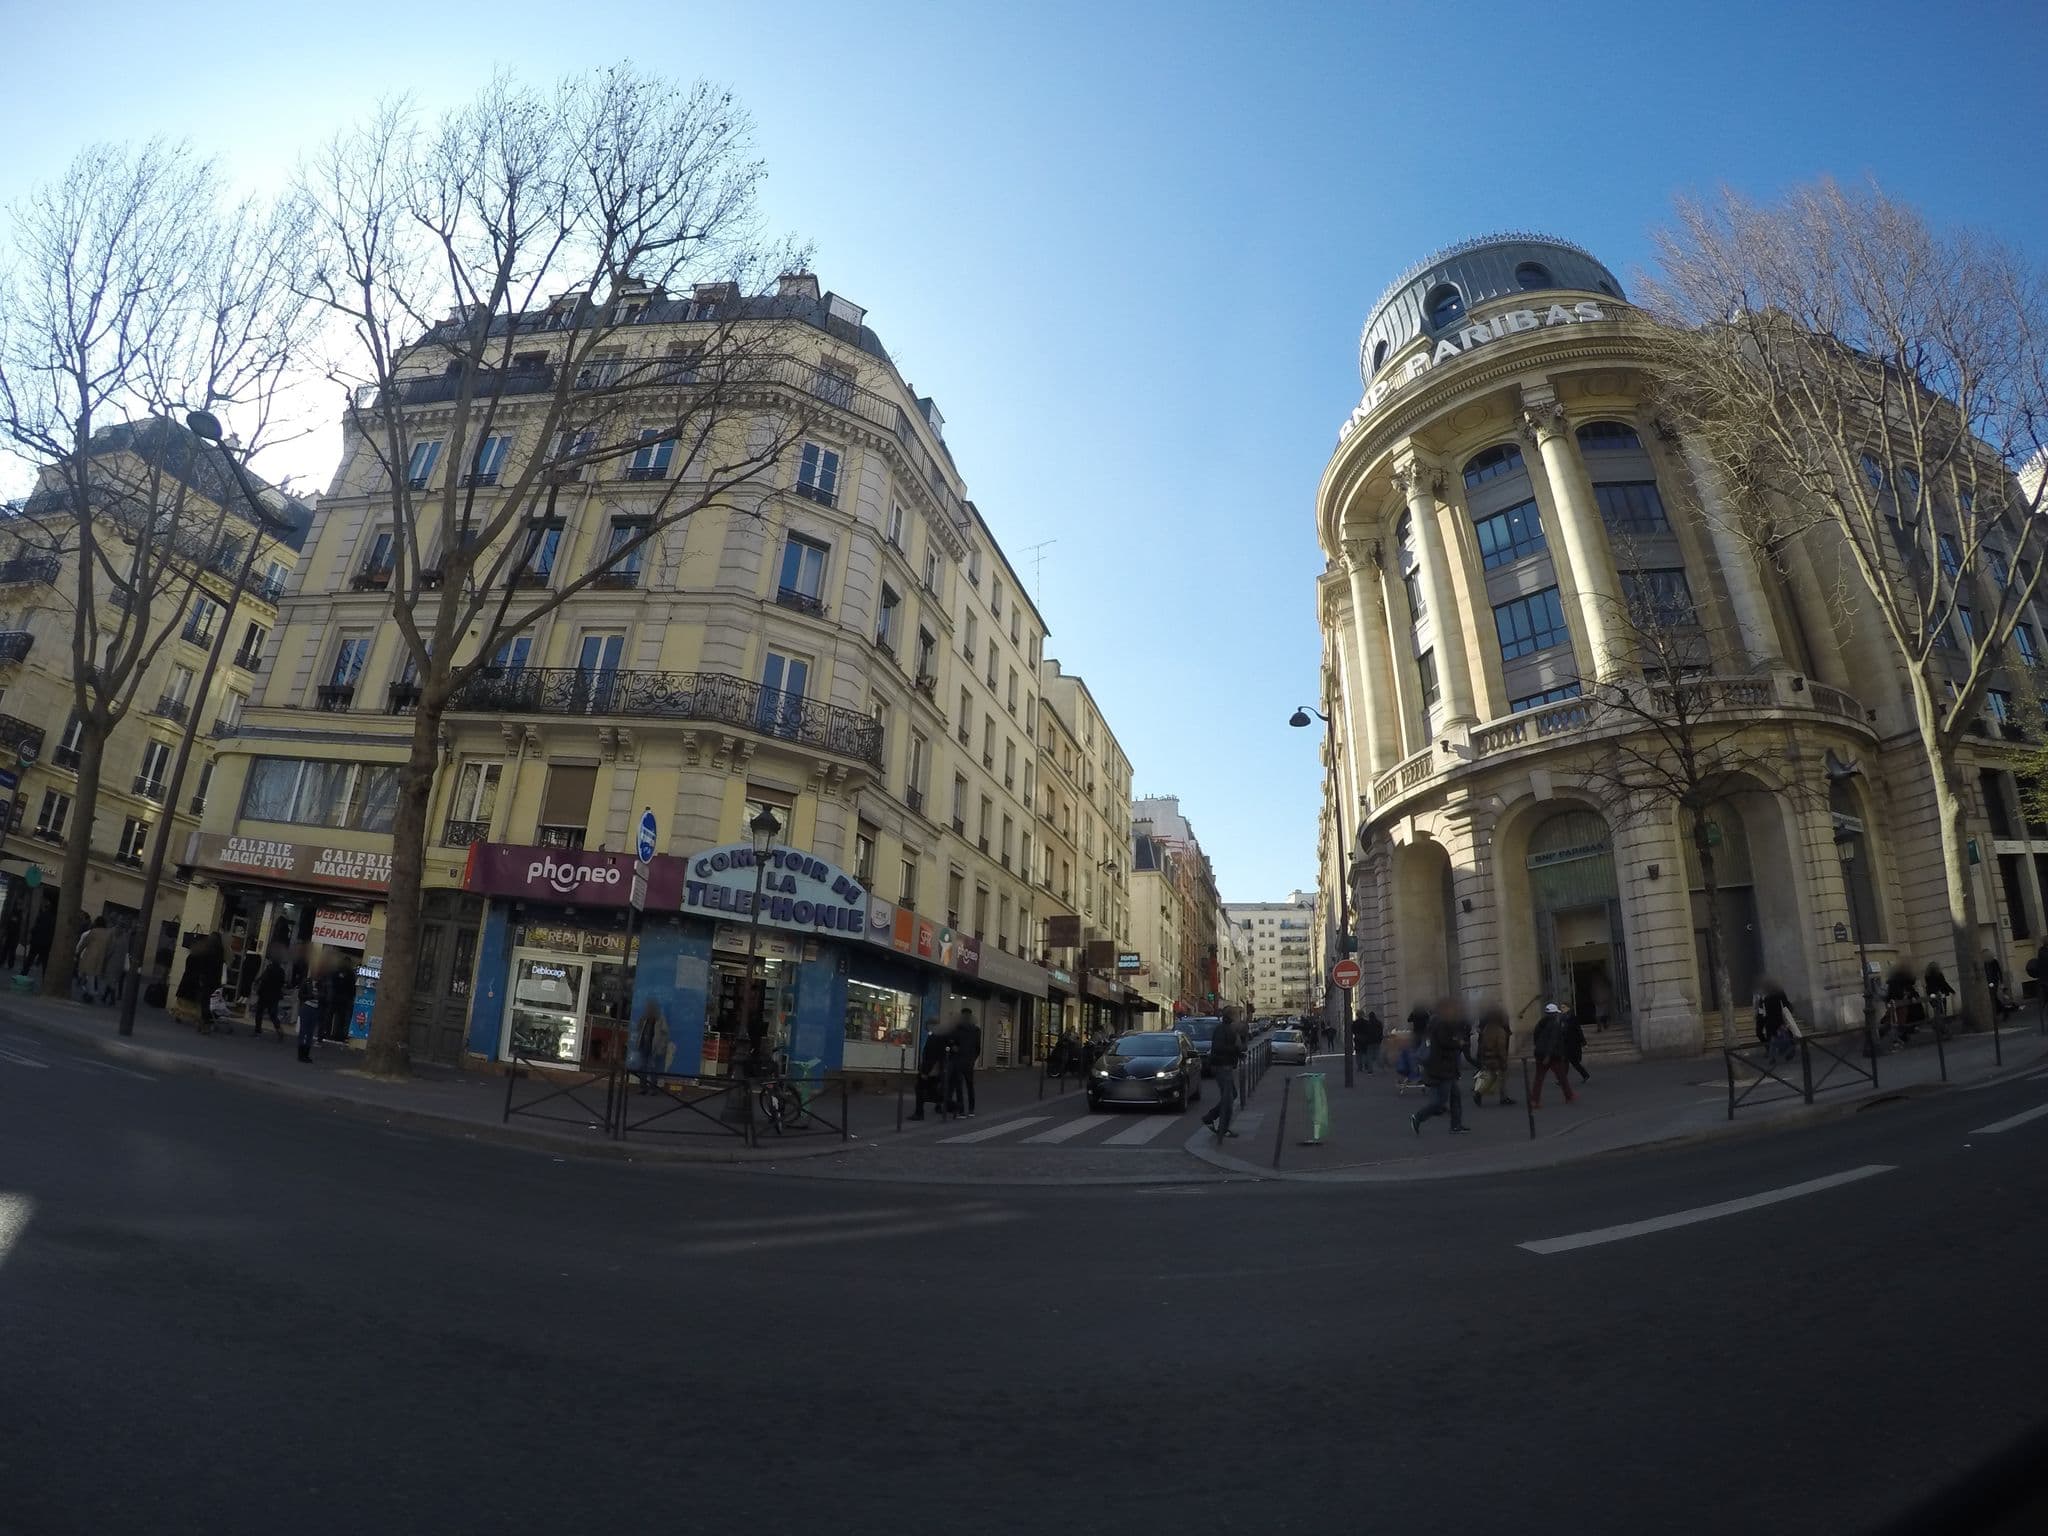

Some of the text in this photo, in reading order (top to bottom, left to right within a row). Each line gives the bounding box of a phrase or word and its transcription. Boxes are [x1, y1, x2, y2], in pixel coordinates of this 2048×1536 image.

[1339, 302, 1604, 442] BNP PARIBAS
[228, 837, 292, 857] GALERIE
[219, 849, 264, 866] MAGIC
[264, 855, 295, 871] FIVE
[312, 861, 392, 882] MAGIC FIV
[526, 855, 621, 890] phoneo
[695, 848, 863, 904] COMTOIR DE
[766, 871, 797, 894] LA
